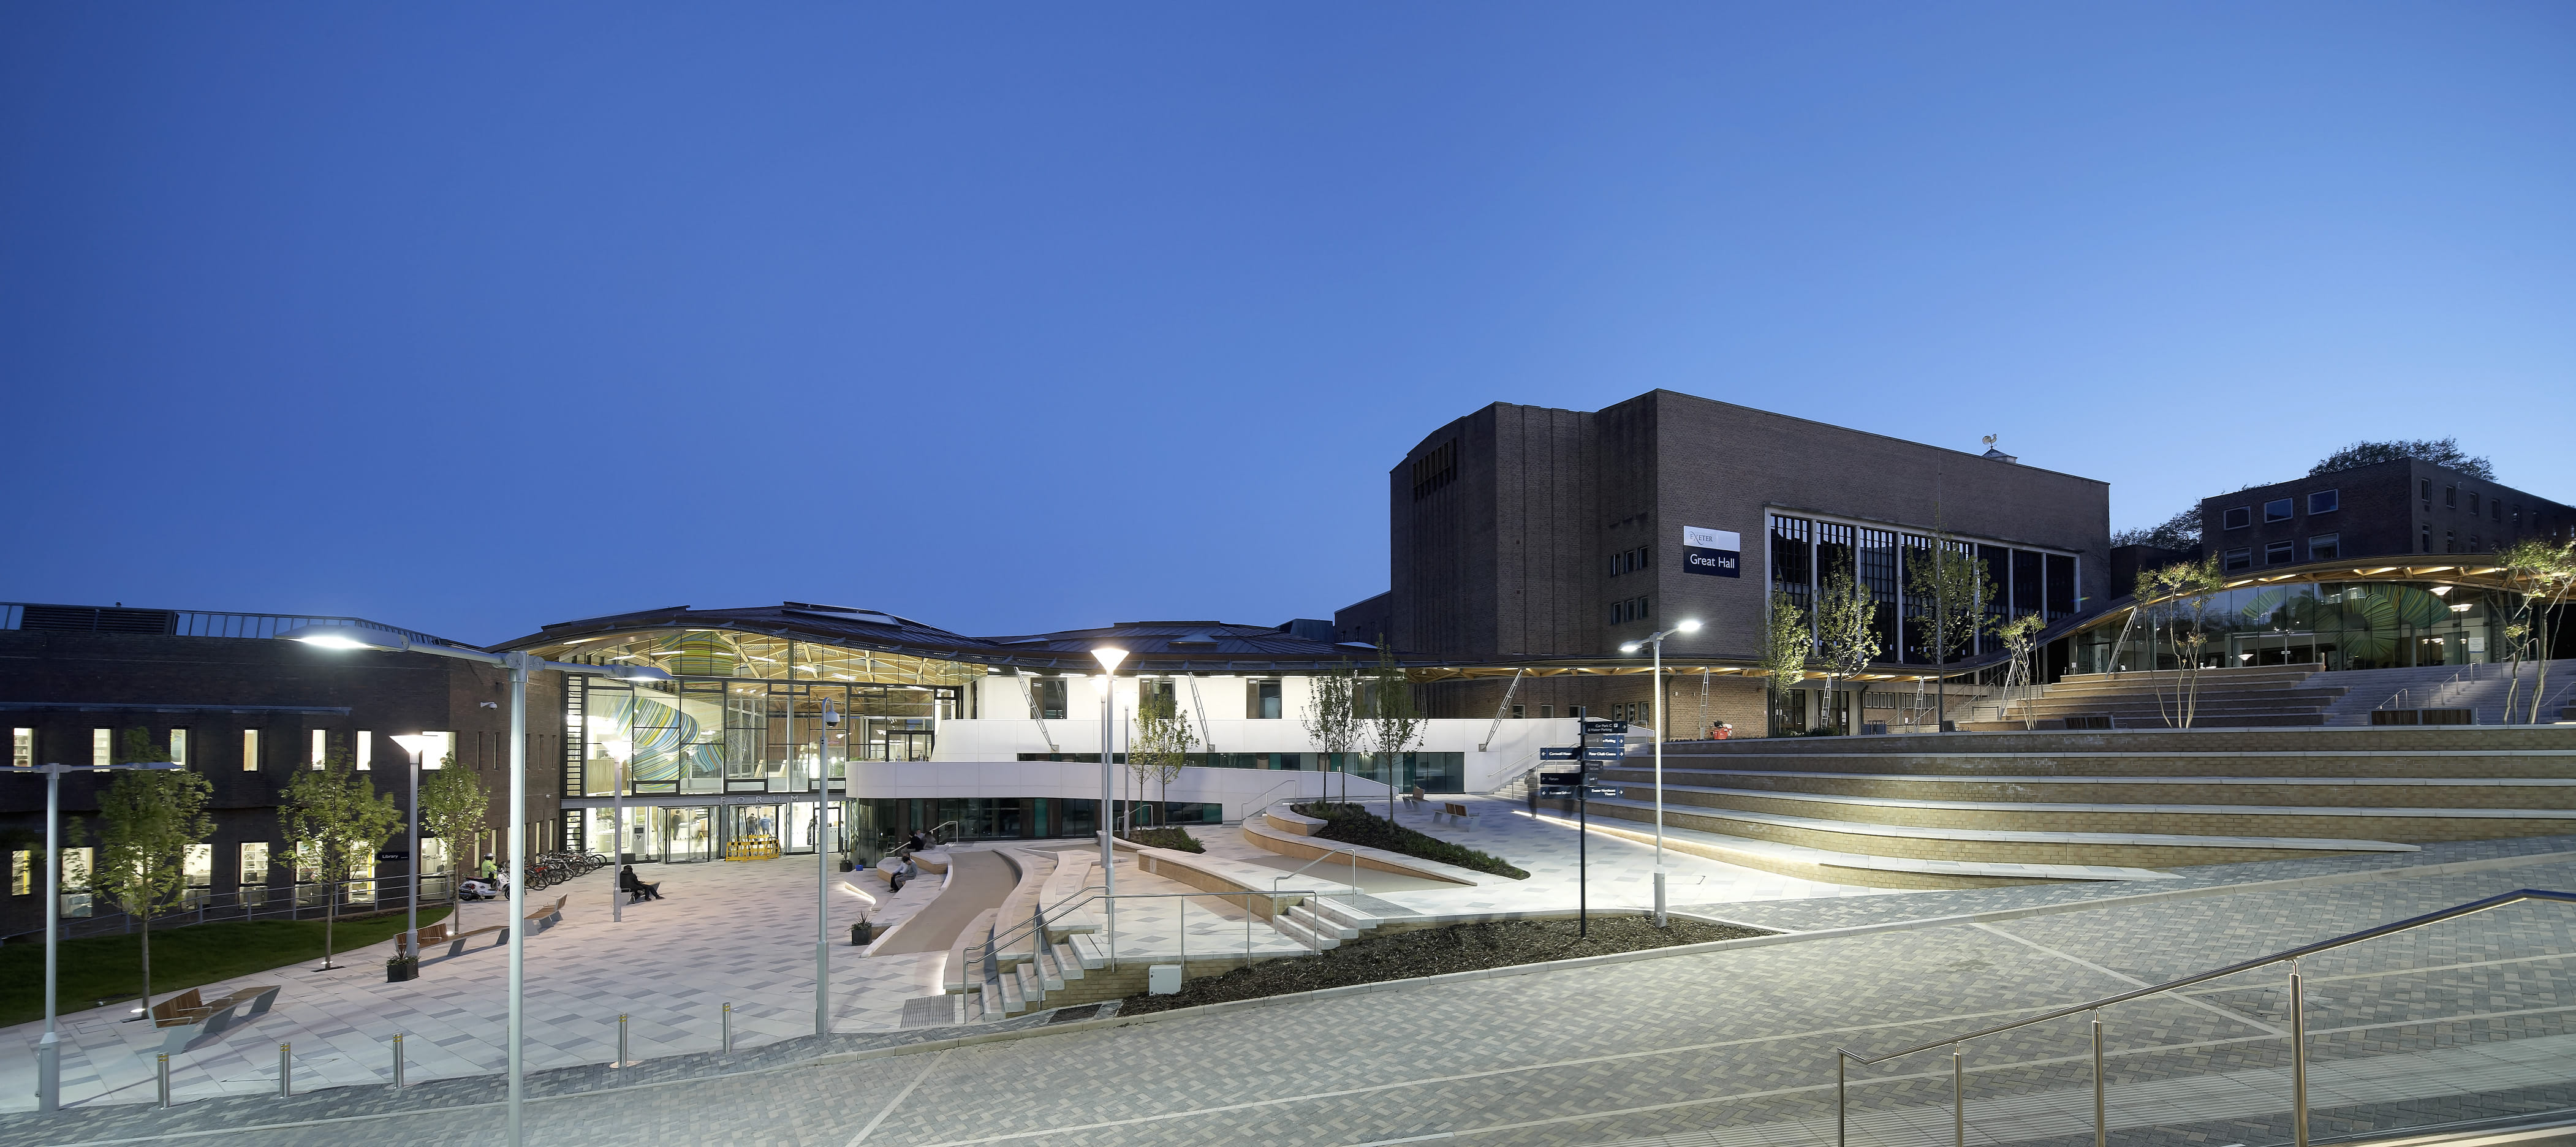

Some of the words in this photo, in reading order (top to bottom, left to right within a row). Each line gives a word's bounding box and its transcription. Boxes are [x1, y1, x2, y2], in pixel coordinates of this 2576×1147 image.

[1689, 531, 1713, 545] EXETER
[1690, 553, 1716, 567] Great
[1718, 556, 1735, 569] Hall
[719, 795, 799, 804] FORUM
